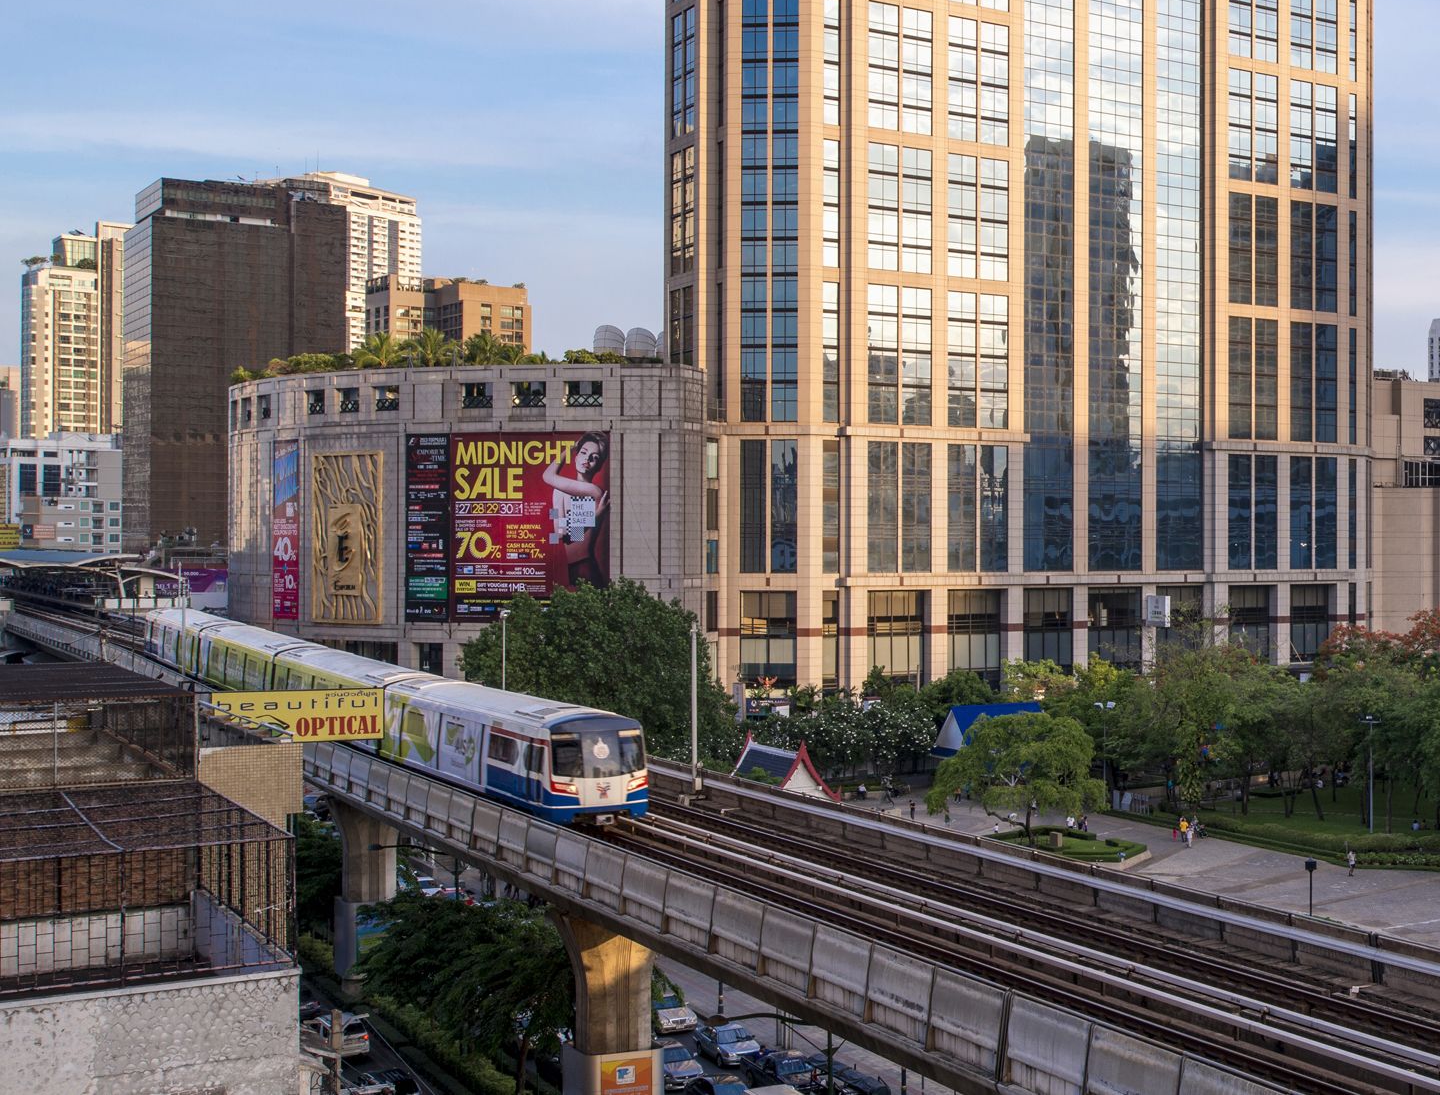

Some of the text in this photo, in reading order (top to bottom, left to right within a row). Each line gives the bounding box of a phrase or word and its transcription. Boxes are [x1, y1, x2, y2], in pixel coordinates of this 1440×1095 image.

[455, 440, 575, 466] MIDNIGHT
[454, 467, 523, 500] SALE
[459, 503, 471, 514] 27
[472, 503, 485, 514] 28
[486, 503, 499, 514] 29
[500, 503, 513, 514] 30
[523, 567, 535, 575] 100
[217, 696, 378, 712] beautiful
[296, 714, 381, 737] OPTICAL
